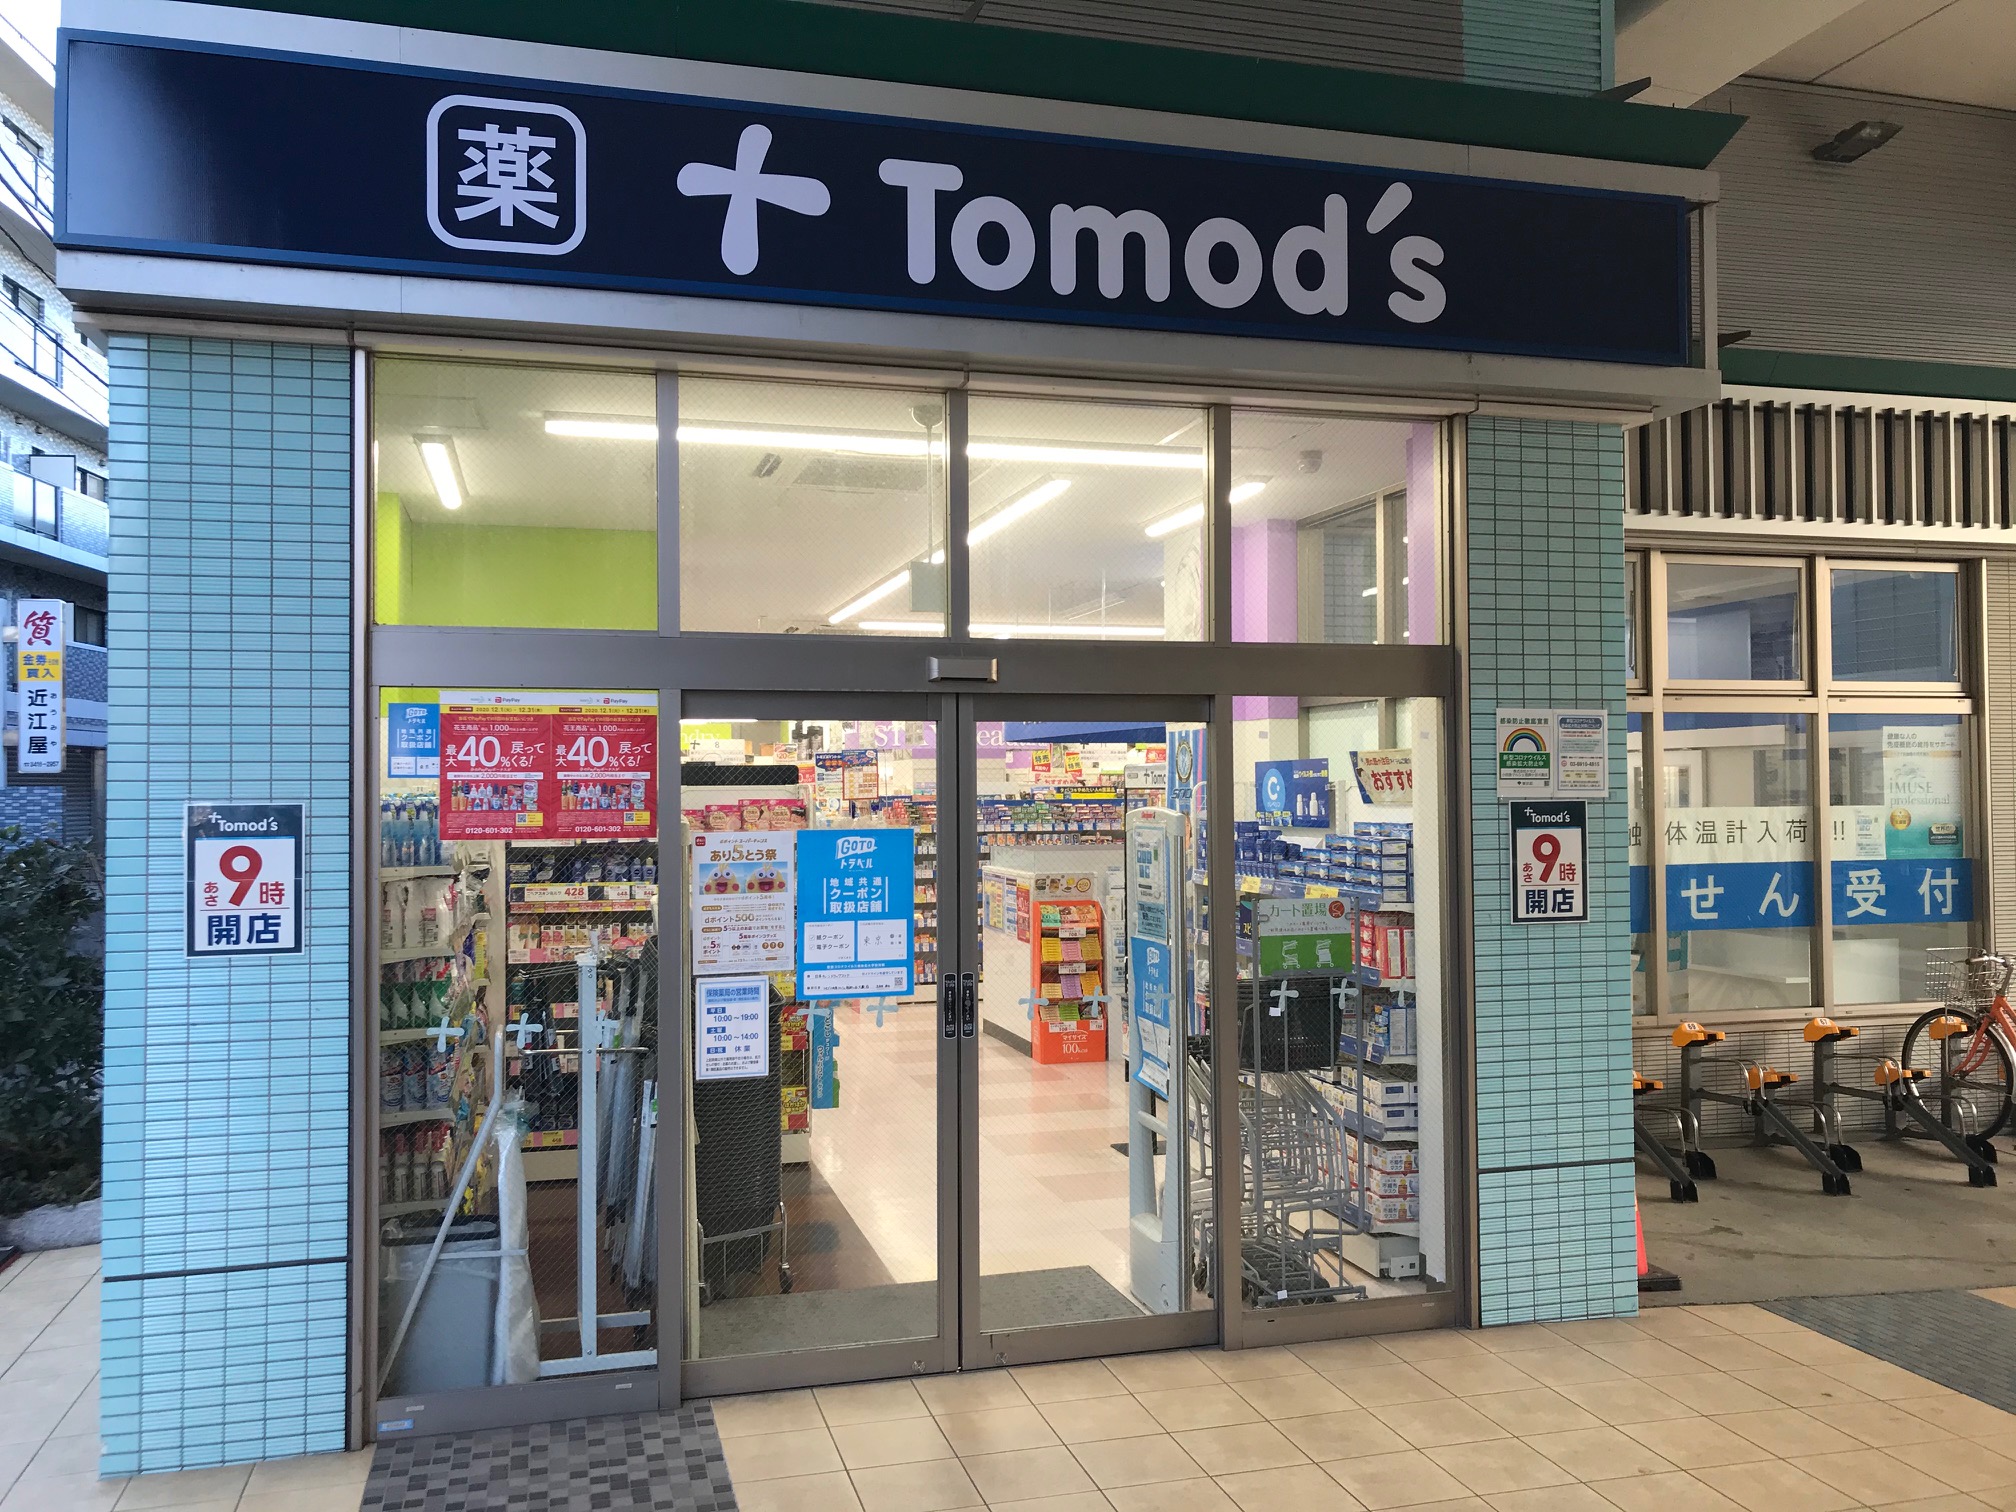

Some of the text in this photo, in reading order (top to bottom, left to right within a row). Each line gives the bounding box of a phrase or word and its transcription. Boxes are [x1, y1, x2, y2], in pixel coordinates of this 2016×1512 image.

[455, 123, 559, 228] 薬
[879, 159, 1447, 323] Tomod's
[24, 611, 57, 646] 質
[23, 654, 47, 666] 金券
[27, 668, 55, 678] 買入
[28, 689, 48, 754] 近江屋
[511, 741, 545, 753] 戻って
[619, 742, 652, 753] 戻って
[1890, 793, 1950, 808] professional
[217, 817, 278, 831] Tomod's
[1530, 811, 1571, 823] Tomod's
[710, 845, 777, 862] あり5とう祭
[840, 858, 873, 869] トラベル
[1522, 862, 1534, 883] あさ
[830, 877, 882, 887] 地域共通
[203, 882, 219, 906] あさ
[564, 888, 584, 896] 428
[830, 887, 882, 900] クーポン
[830, 901, 882, 914] 取扱店舗
[1525, 888, 1575, 915] 開店
[1270, 903, 1327, 917] カート置場
[207, 913, 282, 946] 開店
[706, 987, 760, 997] 保険薬局の営業時間
